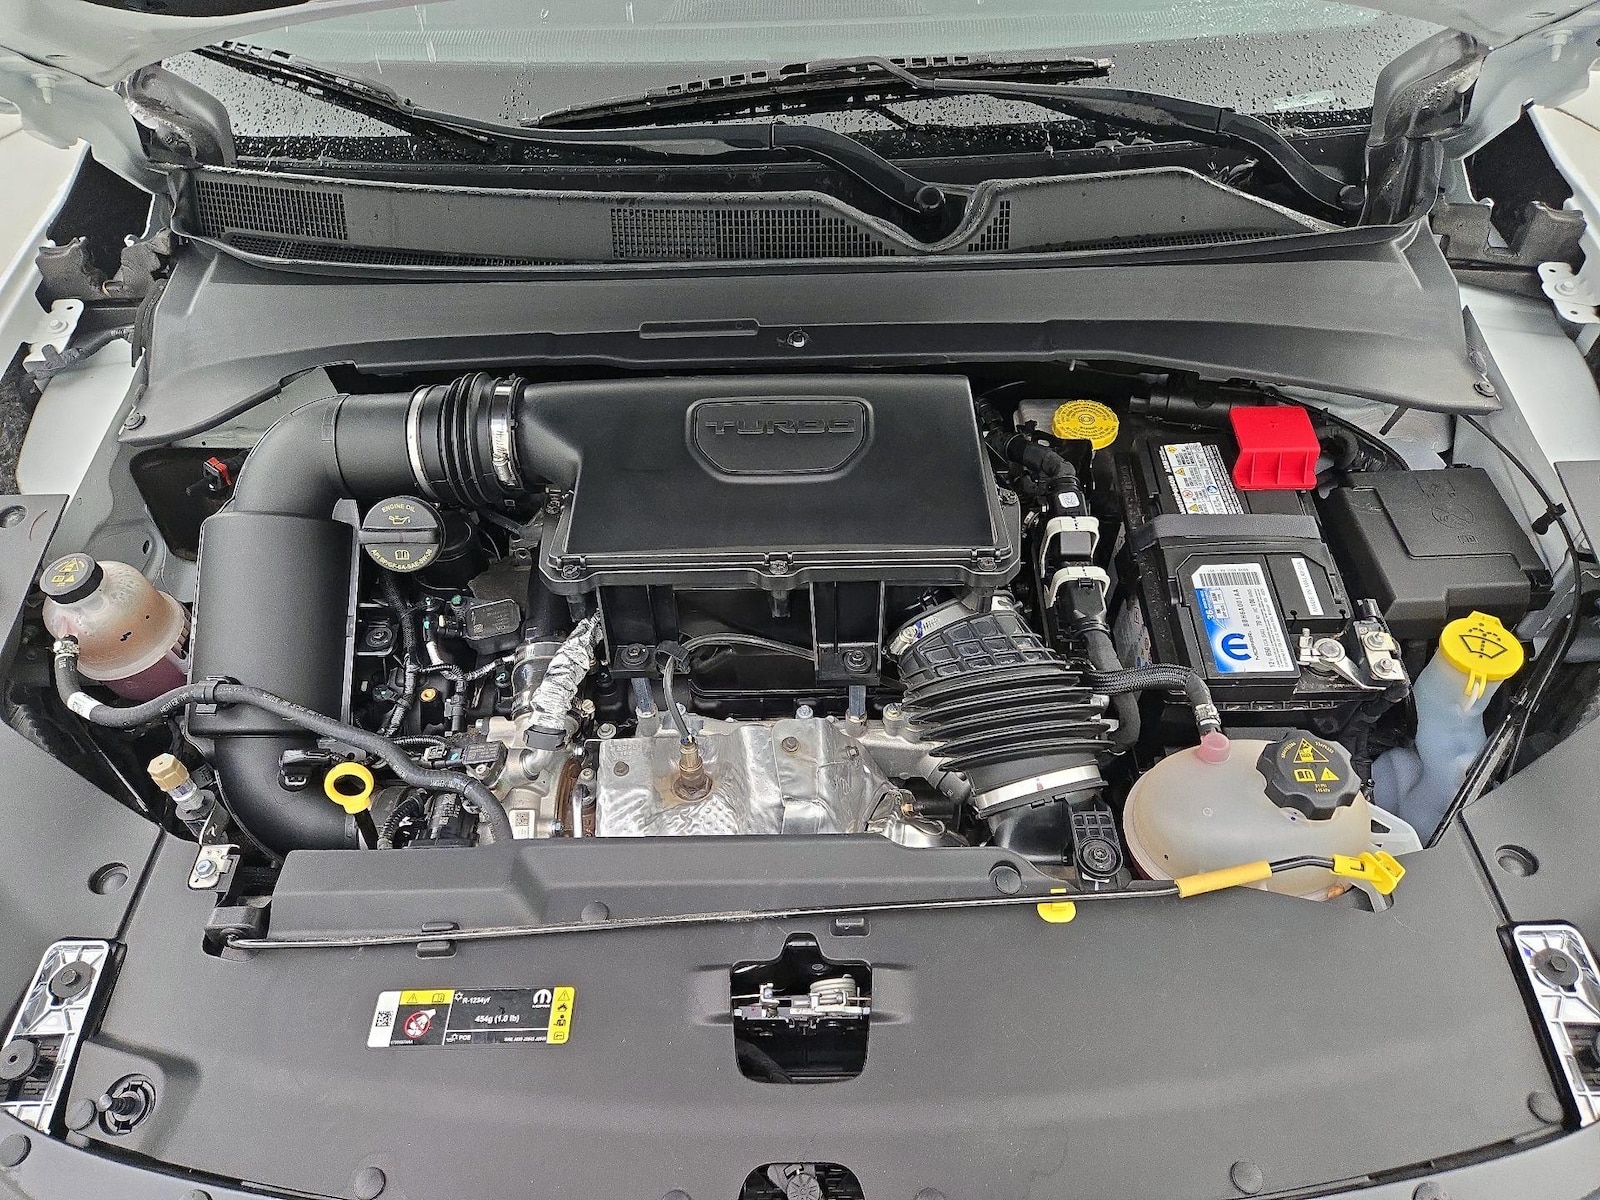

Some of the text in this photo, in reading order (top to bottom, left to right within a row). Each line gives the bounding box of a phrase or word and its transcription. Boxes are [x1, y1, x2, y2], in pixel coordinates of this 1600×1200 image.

[705, 419, 855, 435] TURBO
[382, 503, 416, 513] ENGINE OIL
[1206, 610, 1214, 620] 36
[1247, 632, 1260, 660] MOPAR
[462, 996, 491, 1004] R-1234yf
[474, 1014, 520, 1024] 454g (1.0 lb)
